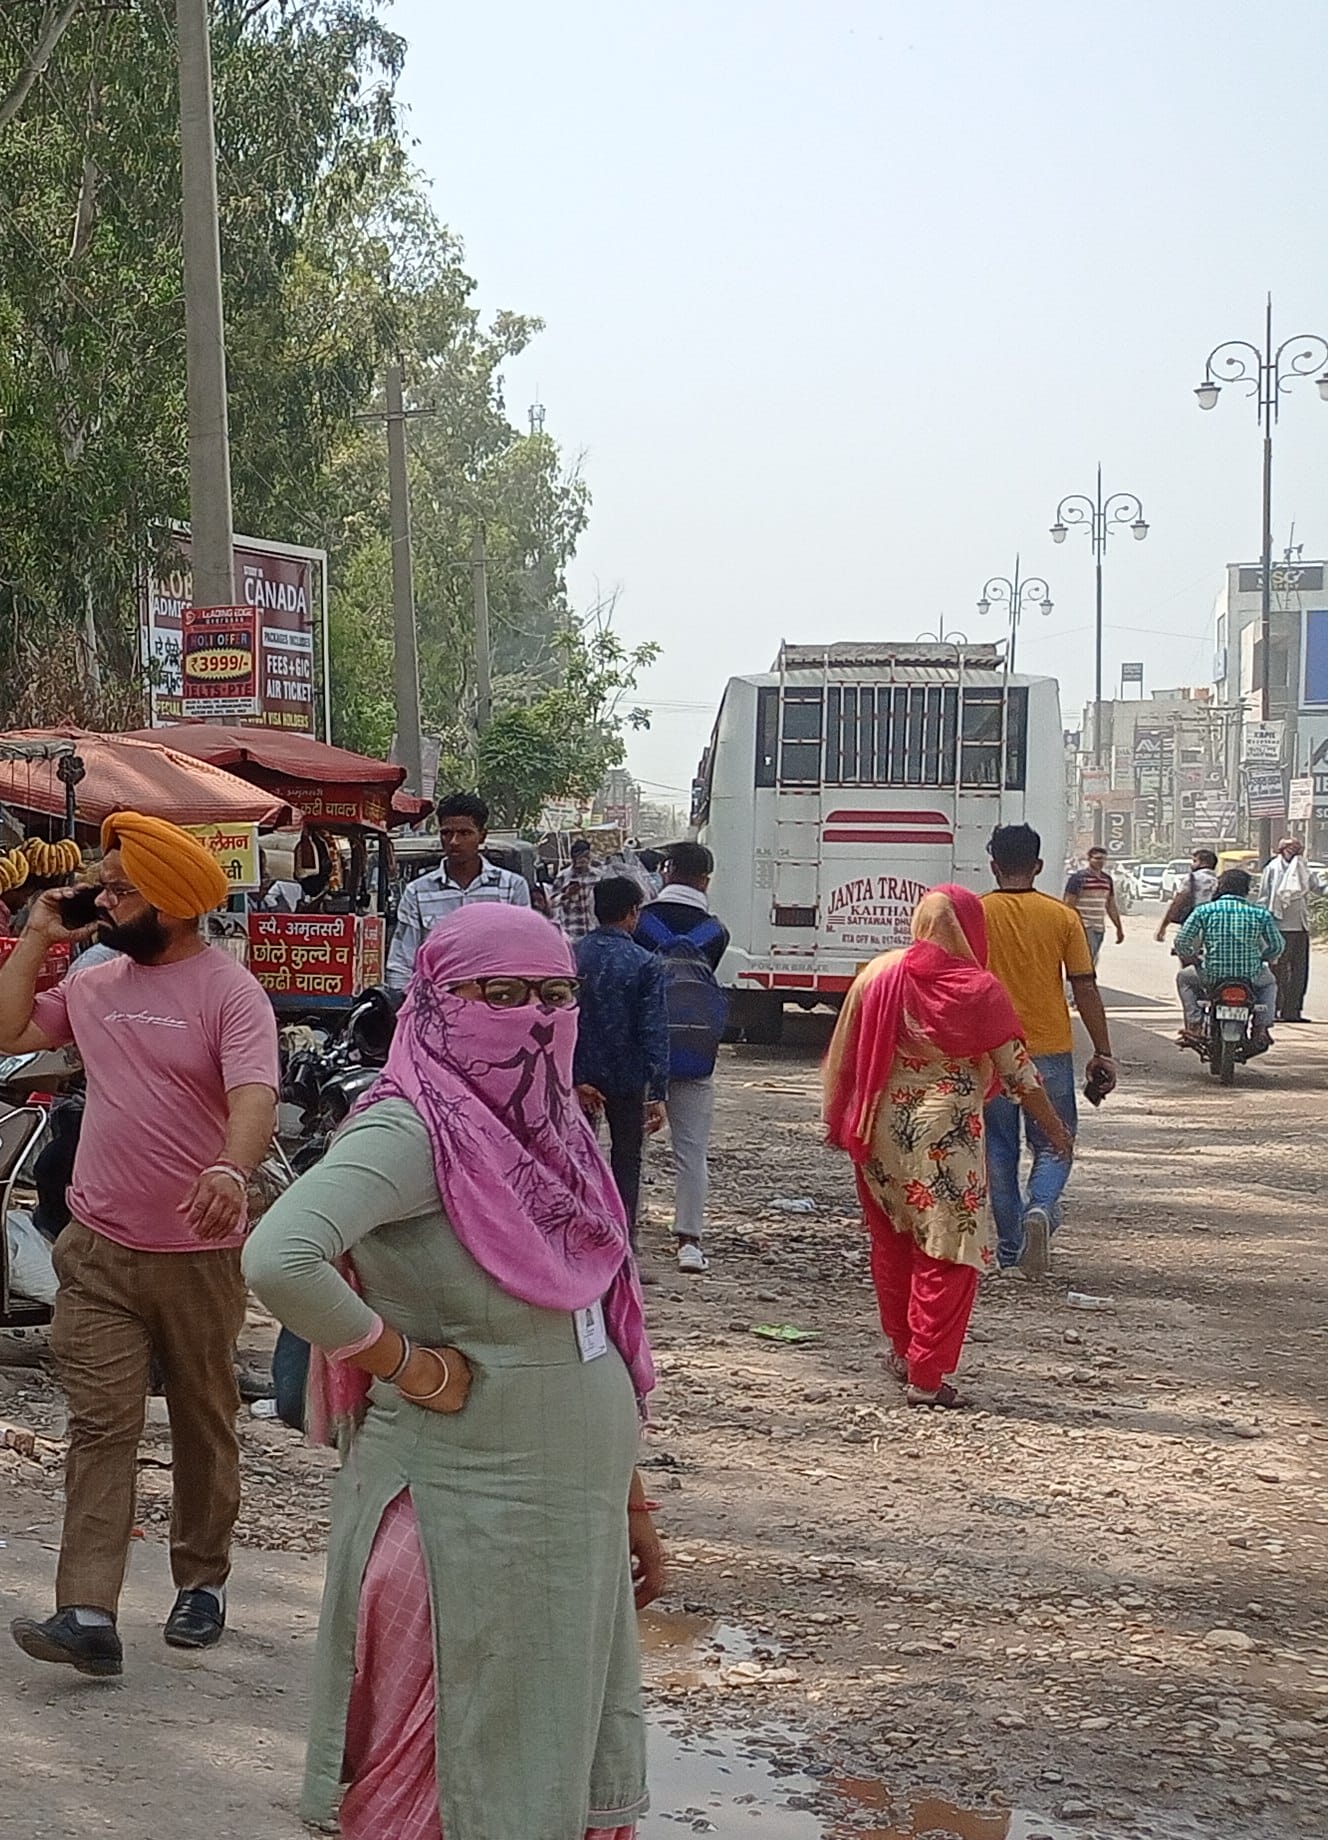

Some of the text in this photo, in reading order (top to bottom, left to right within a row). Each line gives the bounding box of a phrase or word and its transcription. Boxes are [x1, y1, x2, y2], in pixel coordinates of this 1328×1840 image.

[245, 577, 308, 616] CANADA
[266, 679, 312, 702] AIR TICKET
[827, 877, 931, 915] JANTA TRAVE
[285, 918, 345, 941] अमृतसरी
[253, 938, 350, 970] छोले कुल्चे व
[295, 973, 344, 993] चावल
